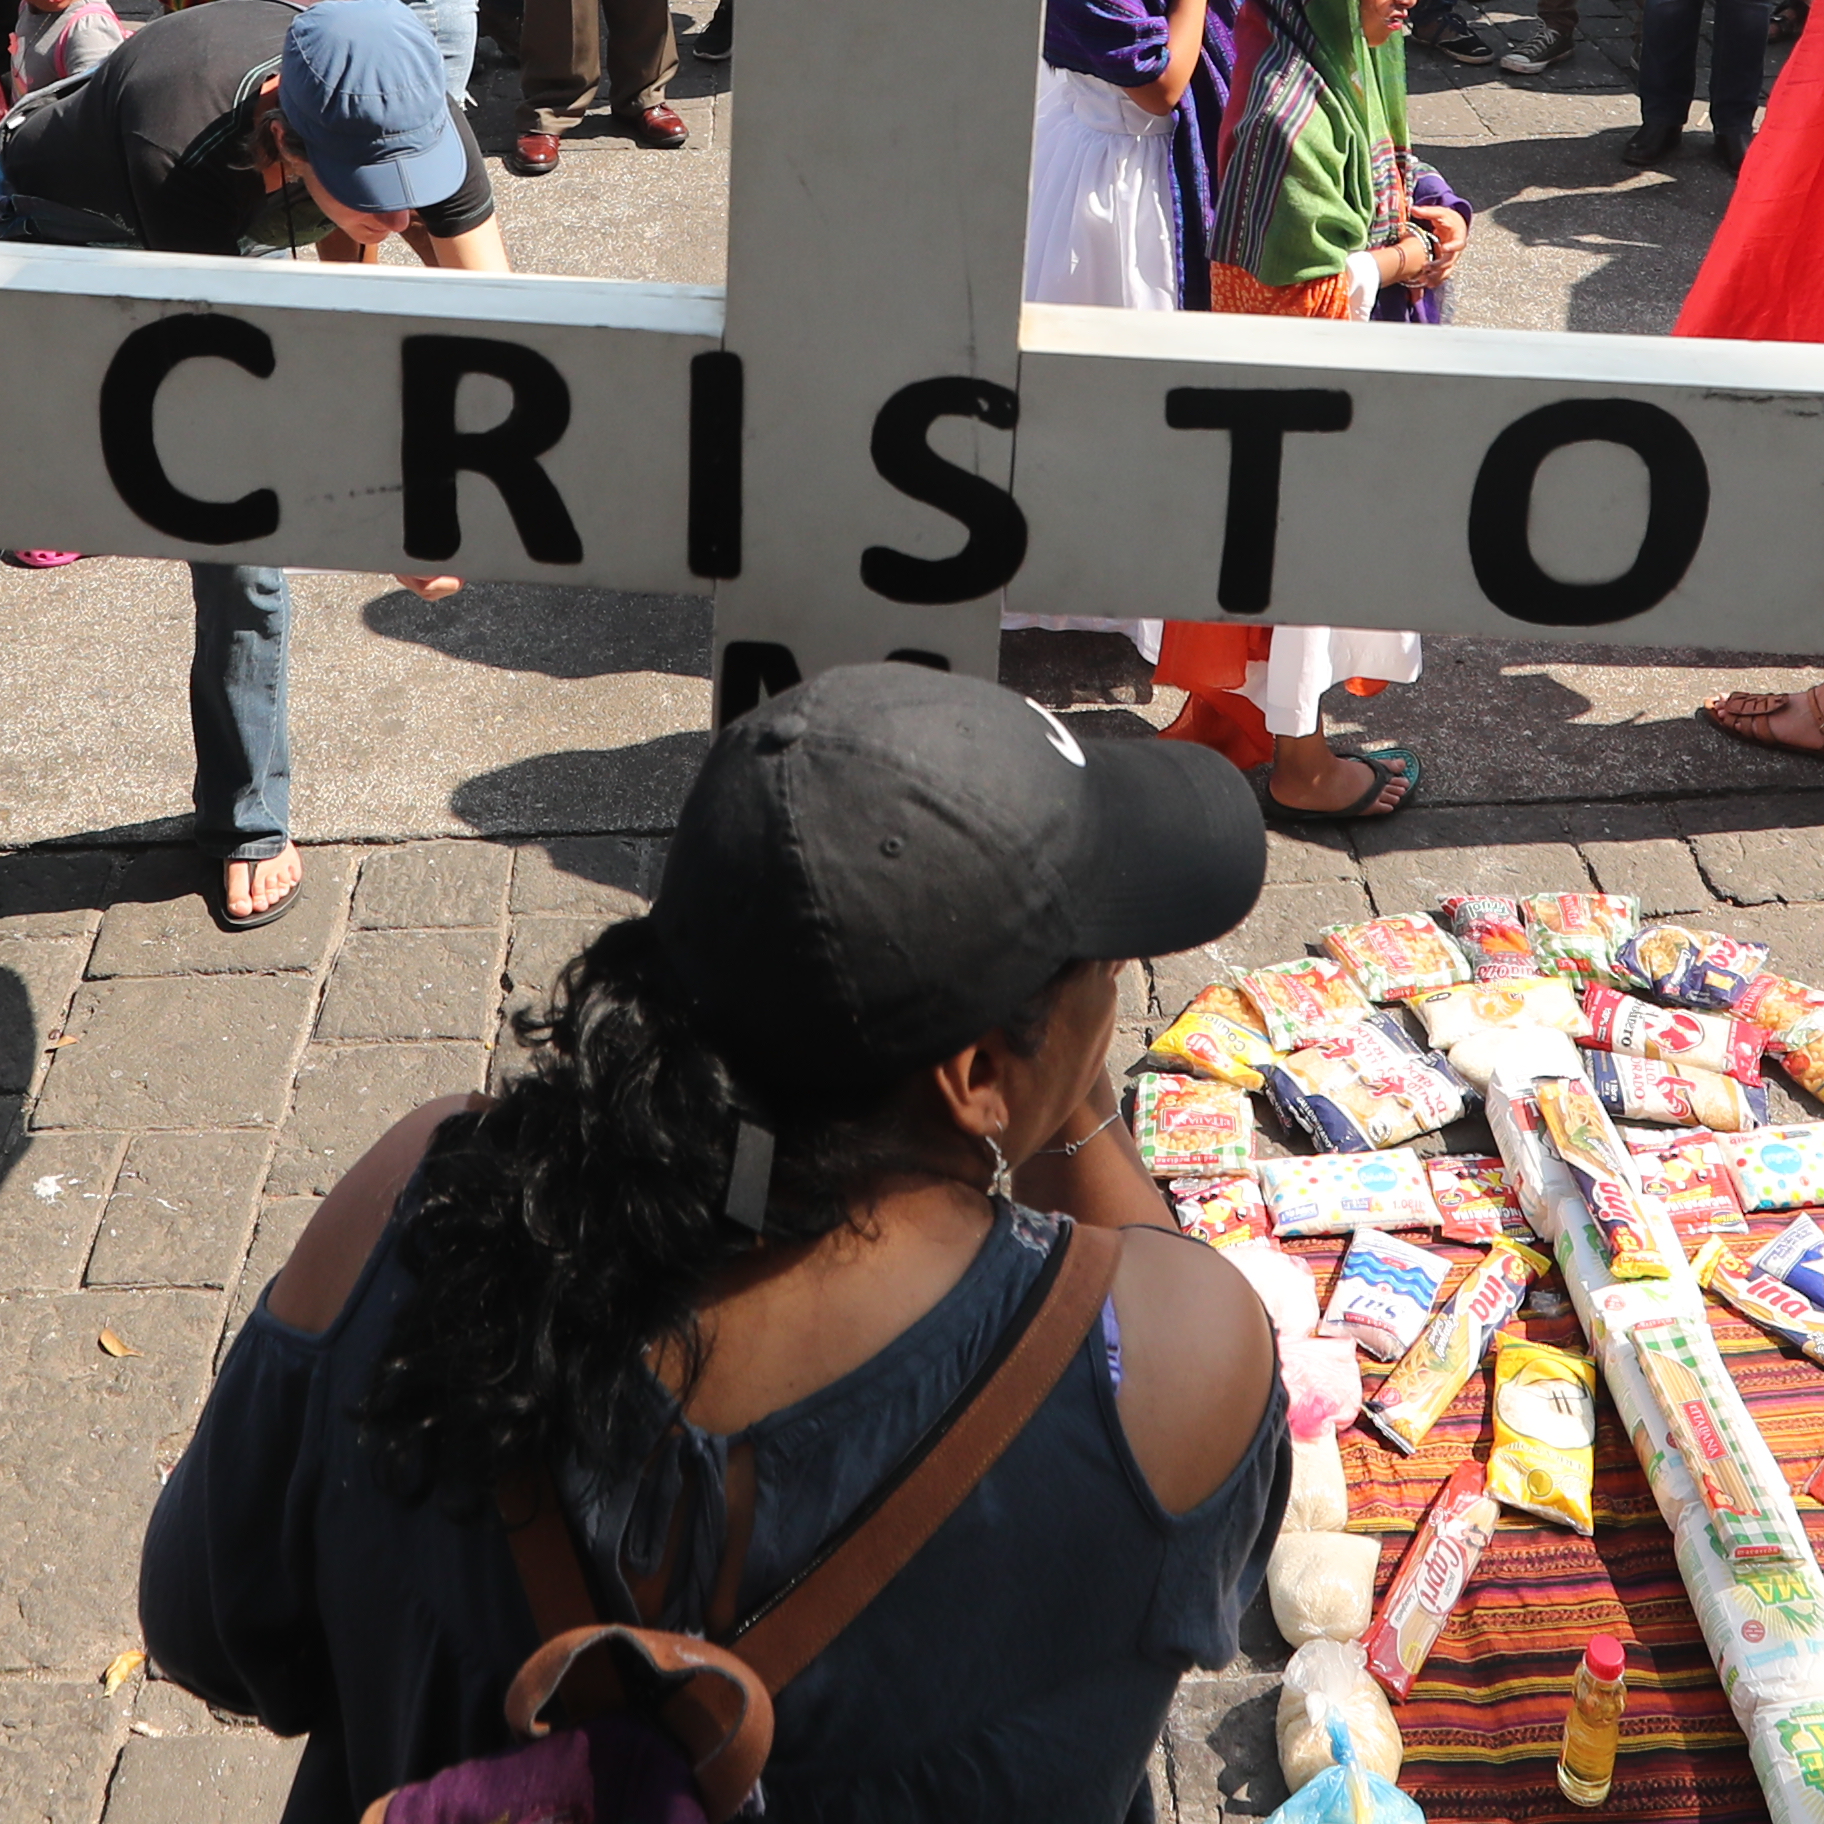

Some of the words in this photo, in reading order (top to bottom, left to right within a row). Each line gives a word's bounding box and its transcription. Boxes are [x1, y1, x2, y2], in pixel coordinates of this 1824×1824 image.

[98, 311, 1714, 630] CRISTO
[1467, 1276, 1517, 1323] ina
[1745, 1275, 1811, 1319] ina
[1419, 1538, 1461, 1614] Capri
